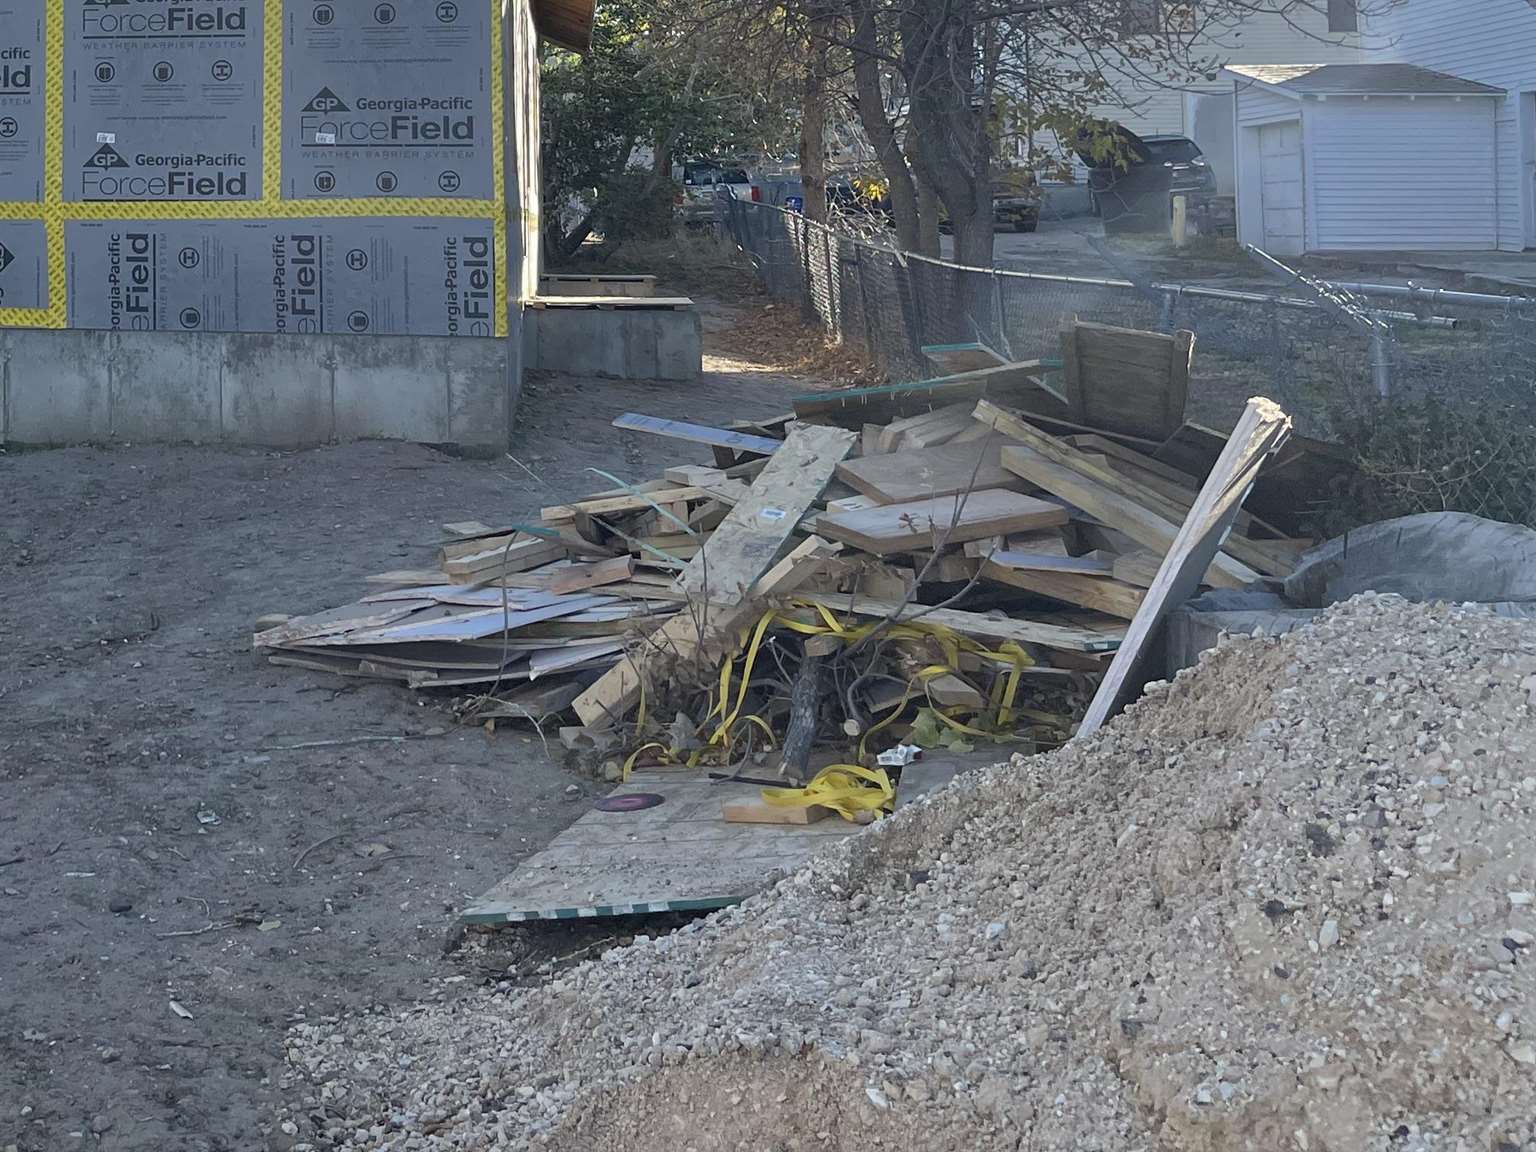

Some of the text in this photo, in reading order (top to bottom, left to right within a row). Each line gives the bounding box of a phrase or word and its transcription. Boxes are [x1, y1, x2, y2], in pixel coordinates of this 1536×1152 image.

[83, 7, 246, 32] ForceField
[356, 96, 473, 114] Georgia-Pacific
[301, 116, 474, 141] ForceField
[135, 153, 246, 171] Georgia-Pacific
[83, 172, 246, 195] ForceField
